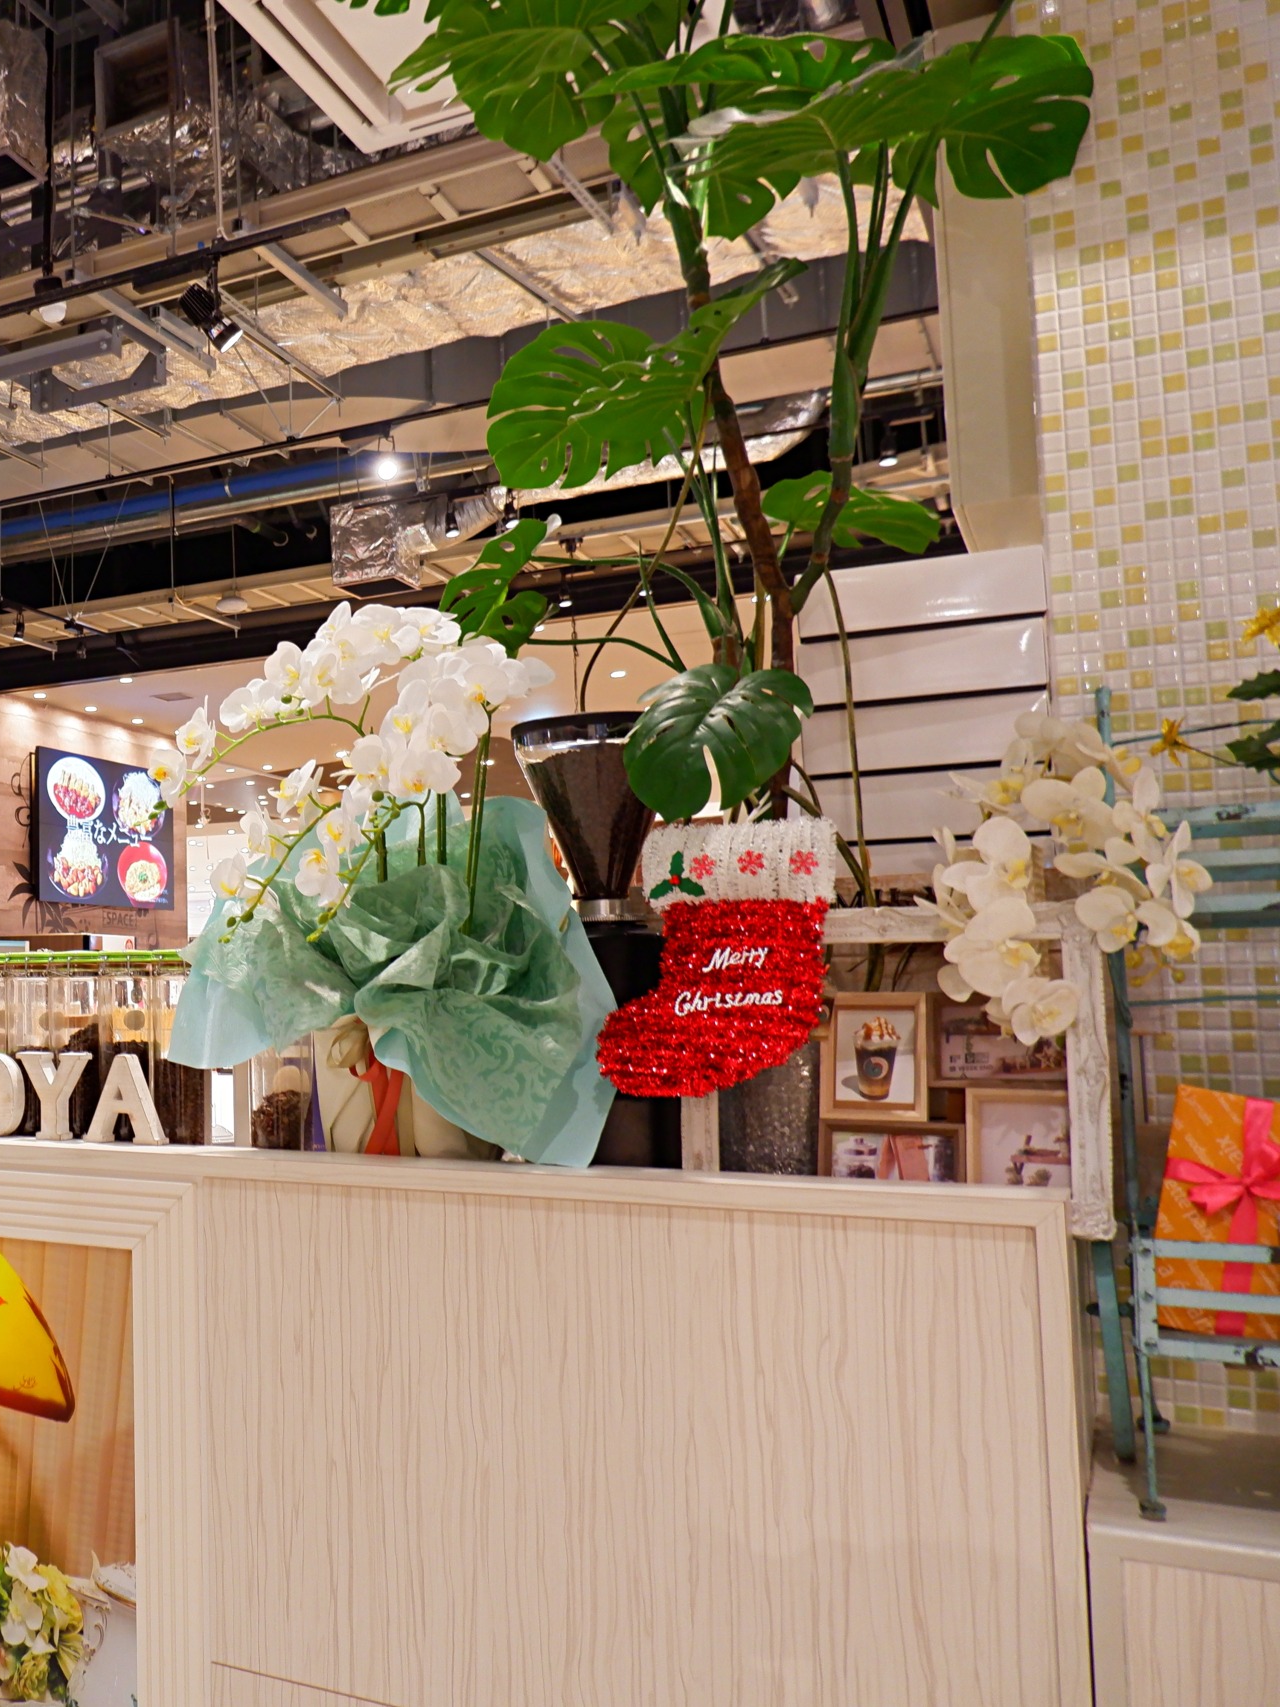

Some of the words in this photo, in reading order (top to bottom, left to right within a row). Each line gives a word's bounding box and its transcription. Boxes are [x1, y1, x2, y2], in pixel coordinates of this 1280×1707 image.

[106, 911, 135, 927] SPACE
[702, 946, 769, 973] Merry
[674, 988, 783, 1017] Christmas
